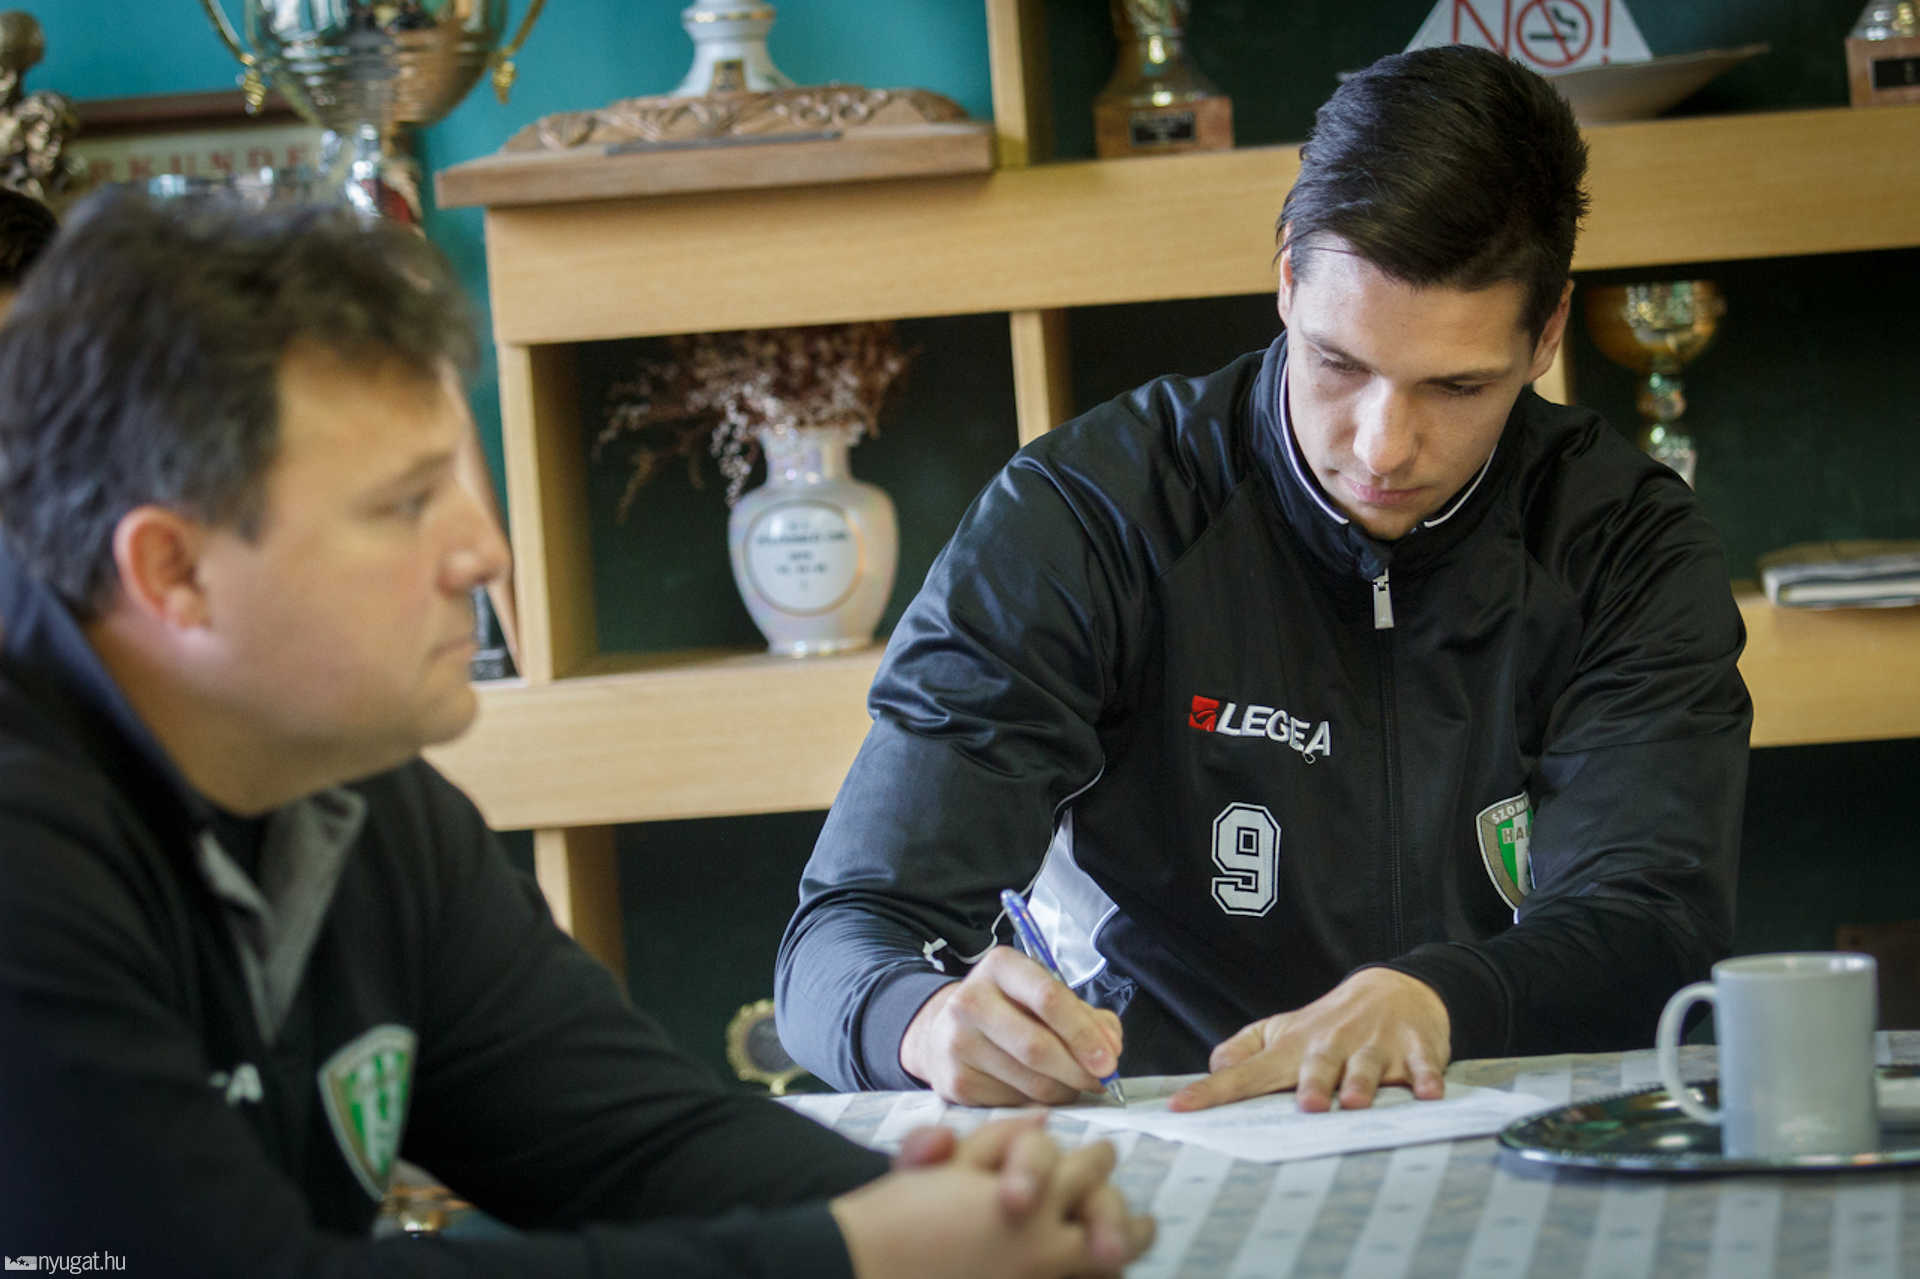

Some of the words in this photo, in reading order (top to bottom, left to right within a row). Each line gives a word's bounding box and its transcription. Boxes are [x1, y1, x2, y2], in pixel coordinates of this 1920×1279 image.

[1216, 702, 1331, 757] LEGEA
[1492, 796, 1529, 825] SZOM
[1211, 802, 1281, 917] 9
